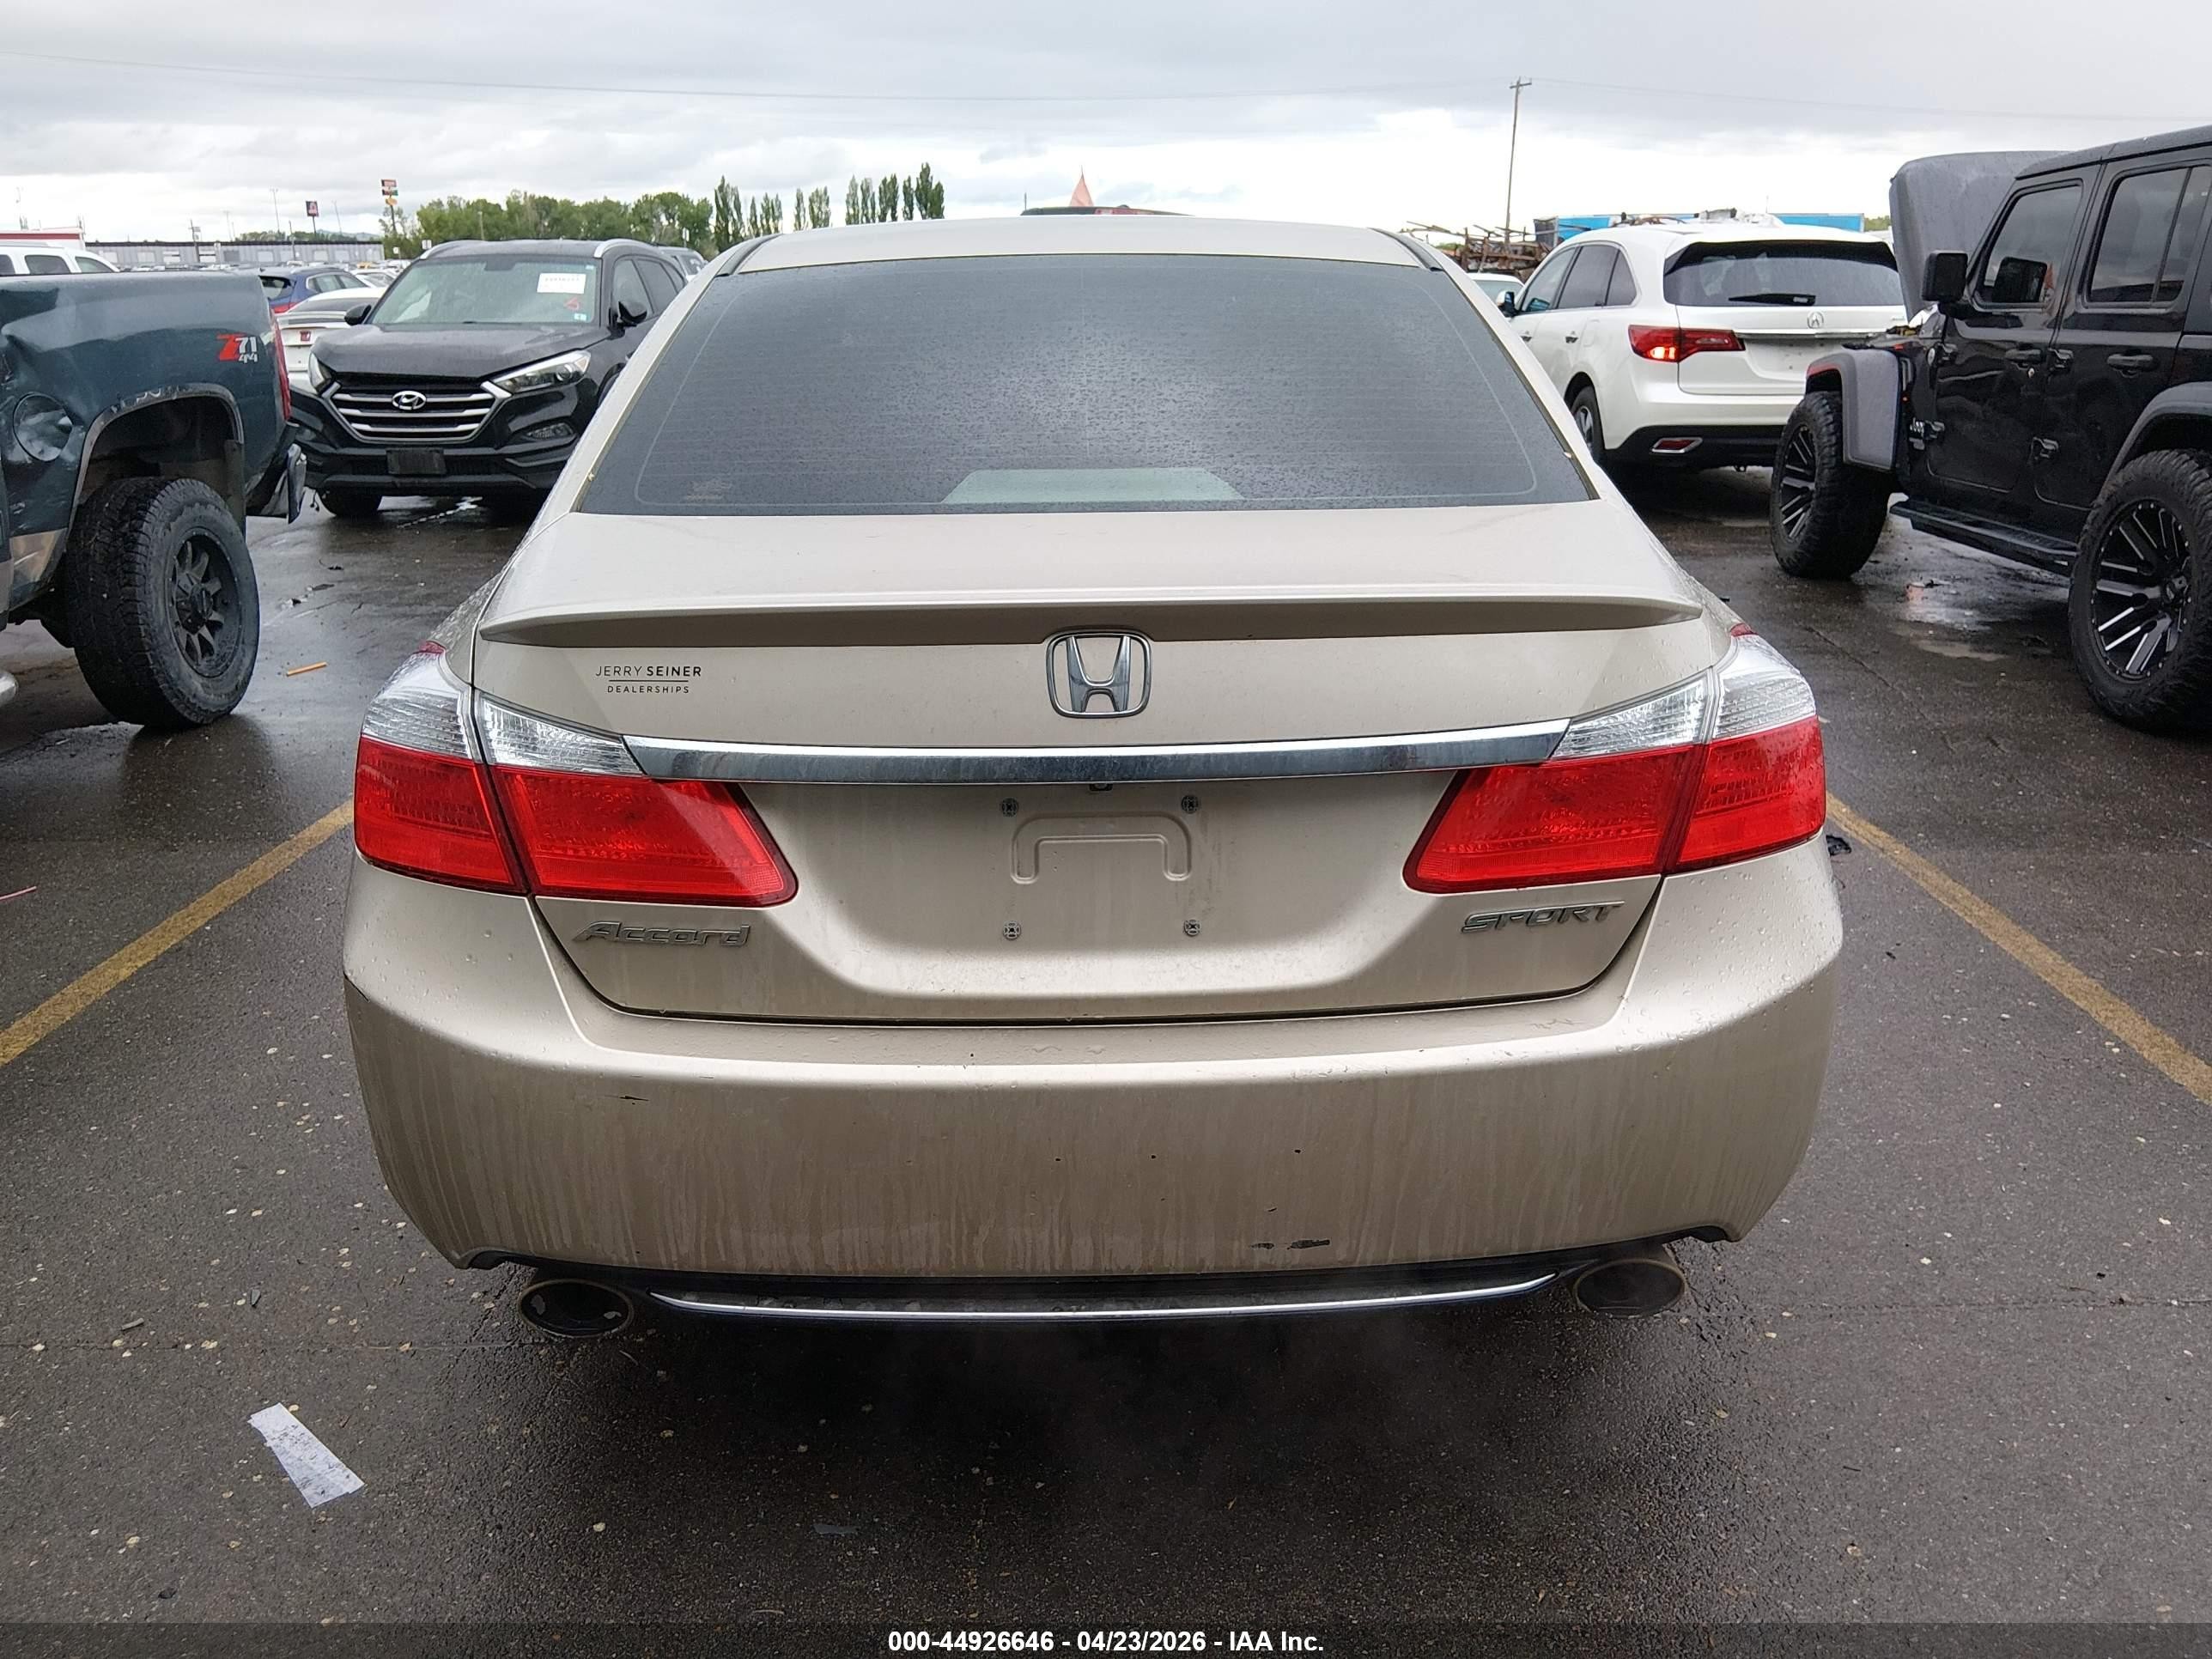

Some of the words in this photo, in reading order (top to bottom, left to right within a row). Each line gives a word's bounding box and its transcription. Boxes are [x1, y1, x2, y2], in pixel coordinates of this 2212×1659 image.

[216, 332, 258, 361] Z71
[595, 665, 642, 677] JERRY
[647, 665, 702, 677] SEINER
[607, 685, 689, 694] DEALERSHIPS
[1462, 901, 1625, 933] SPORT
[573, 921, 750, 946] Accord
